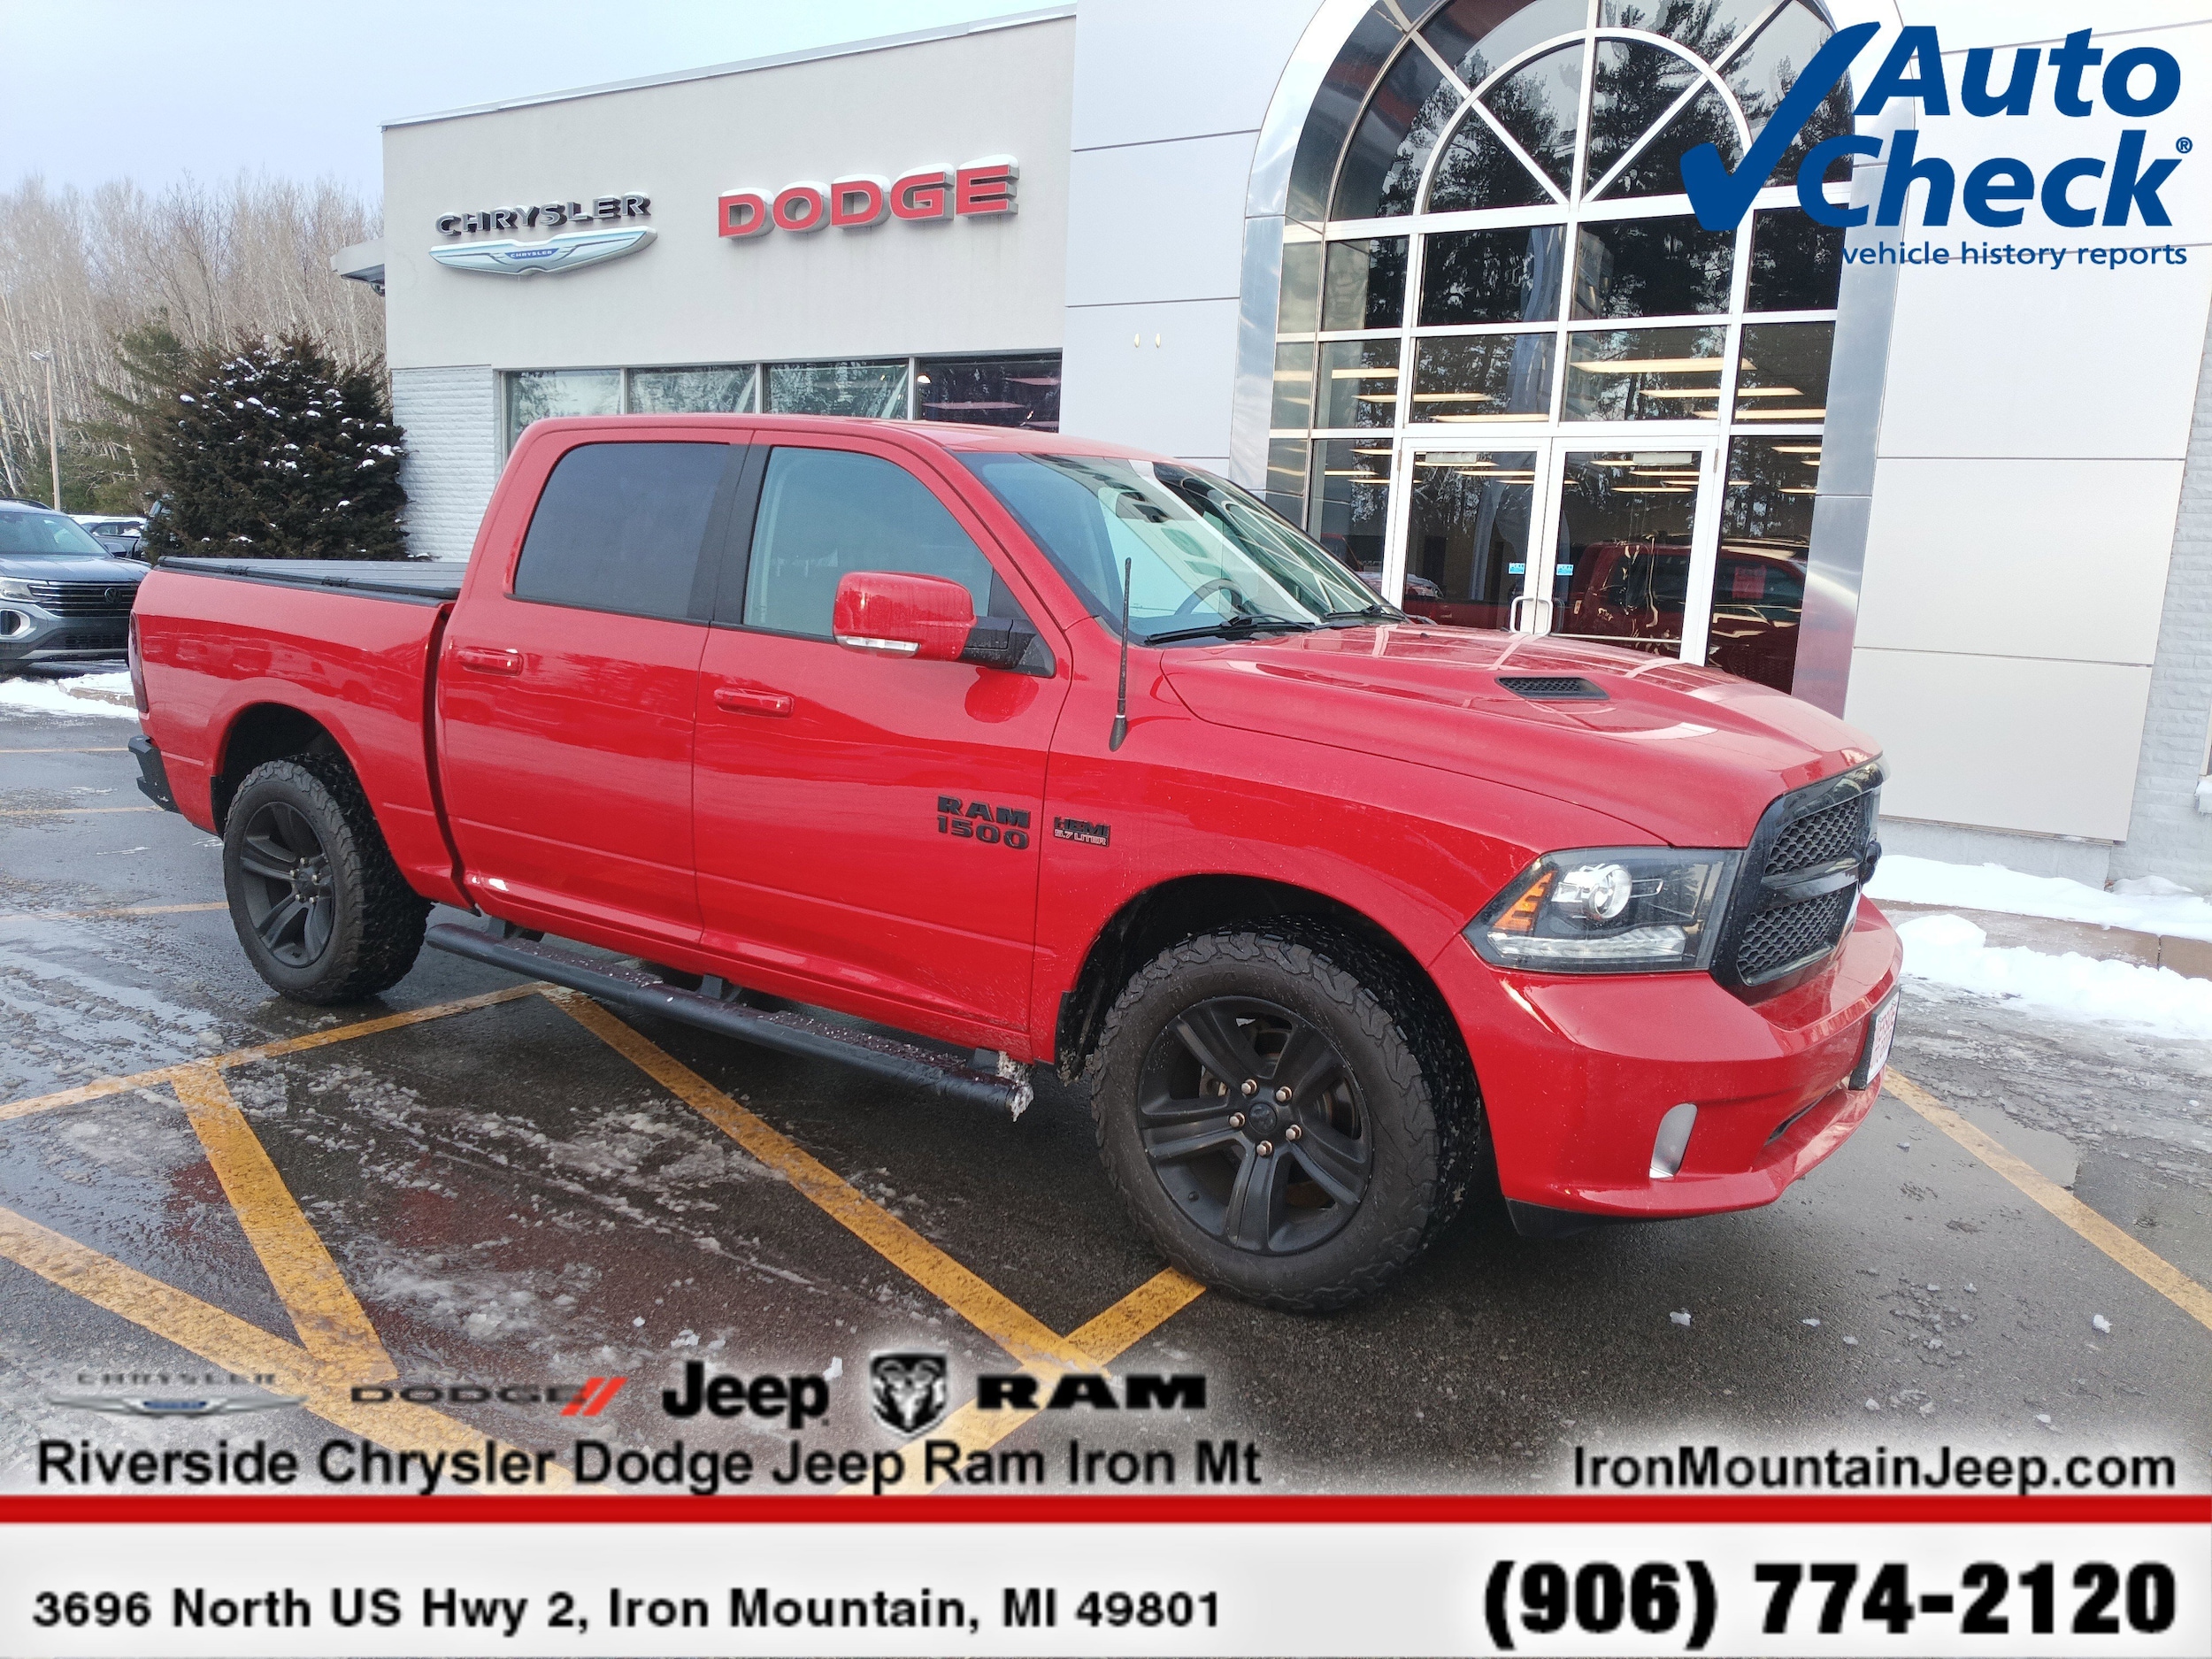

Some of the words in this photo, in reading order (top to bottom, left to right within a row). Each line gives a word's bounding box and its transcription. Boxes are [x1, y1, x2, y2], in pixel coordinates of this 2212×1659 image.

[718, 154, 1019, 239] DODGE
[434, 192, 651, 237] CHRYSLER
[510, 249, 553, 259] CHRYSLER
[937, 795, 1031, 829] RAM
[1054, 816, 1111, 837] HEMI
[937, 814, 1030, 850] 1500
[1054, 828, 1073, 839] 5.7
[1074, 833, 1107, 846] LITER
